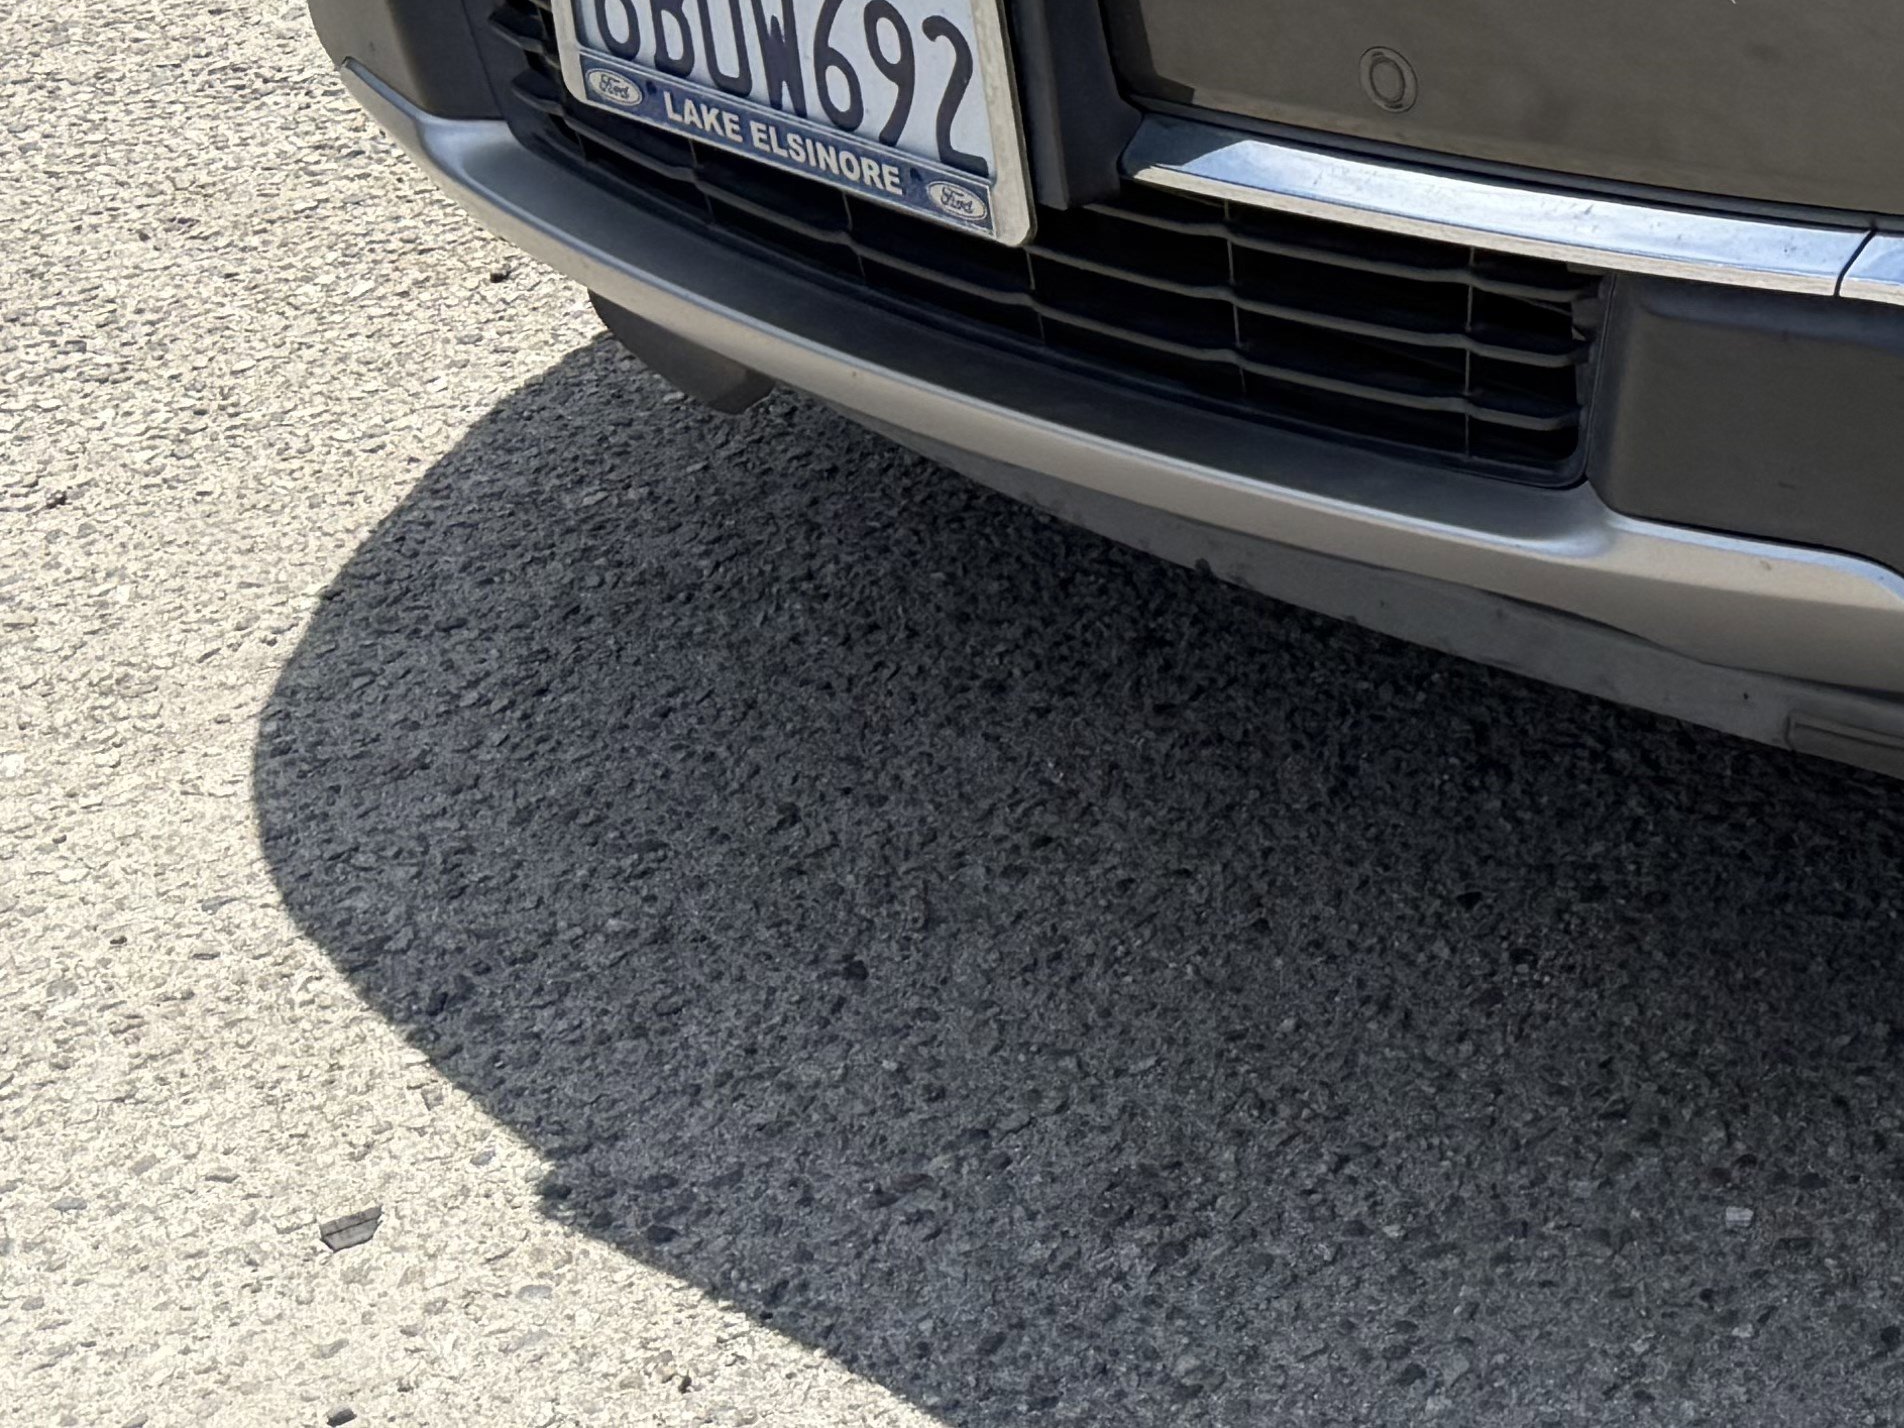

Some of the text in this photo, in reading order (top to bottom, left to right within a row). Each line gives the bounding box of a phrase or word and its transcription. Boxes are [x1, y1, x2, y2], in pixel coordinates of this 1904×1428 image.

[599, 72, 630, 99] Ford
[664, 89, 904, 195] LAKE ELSINORE
[941, 185, 974, 214] Ford
